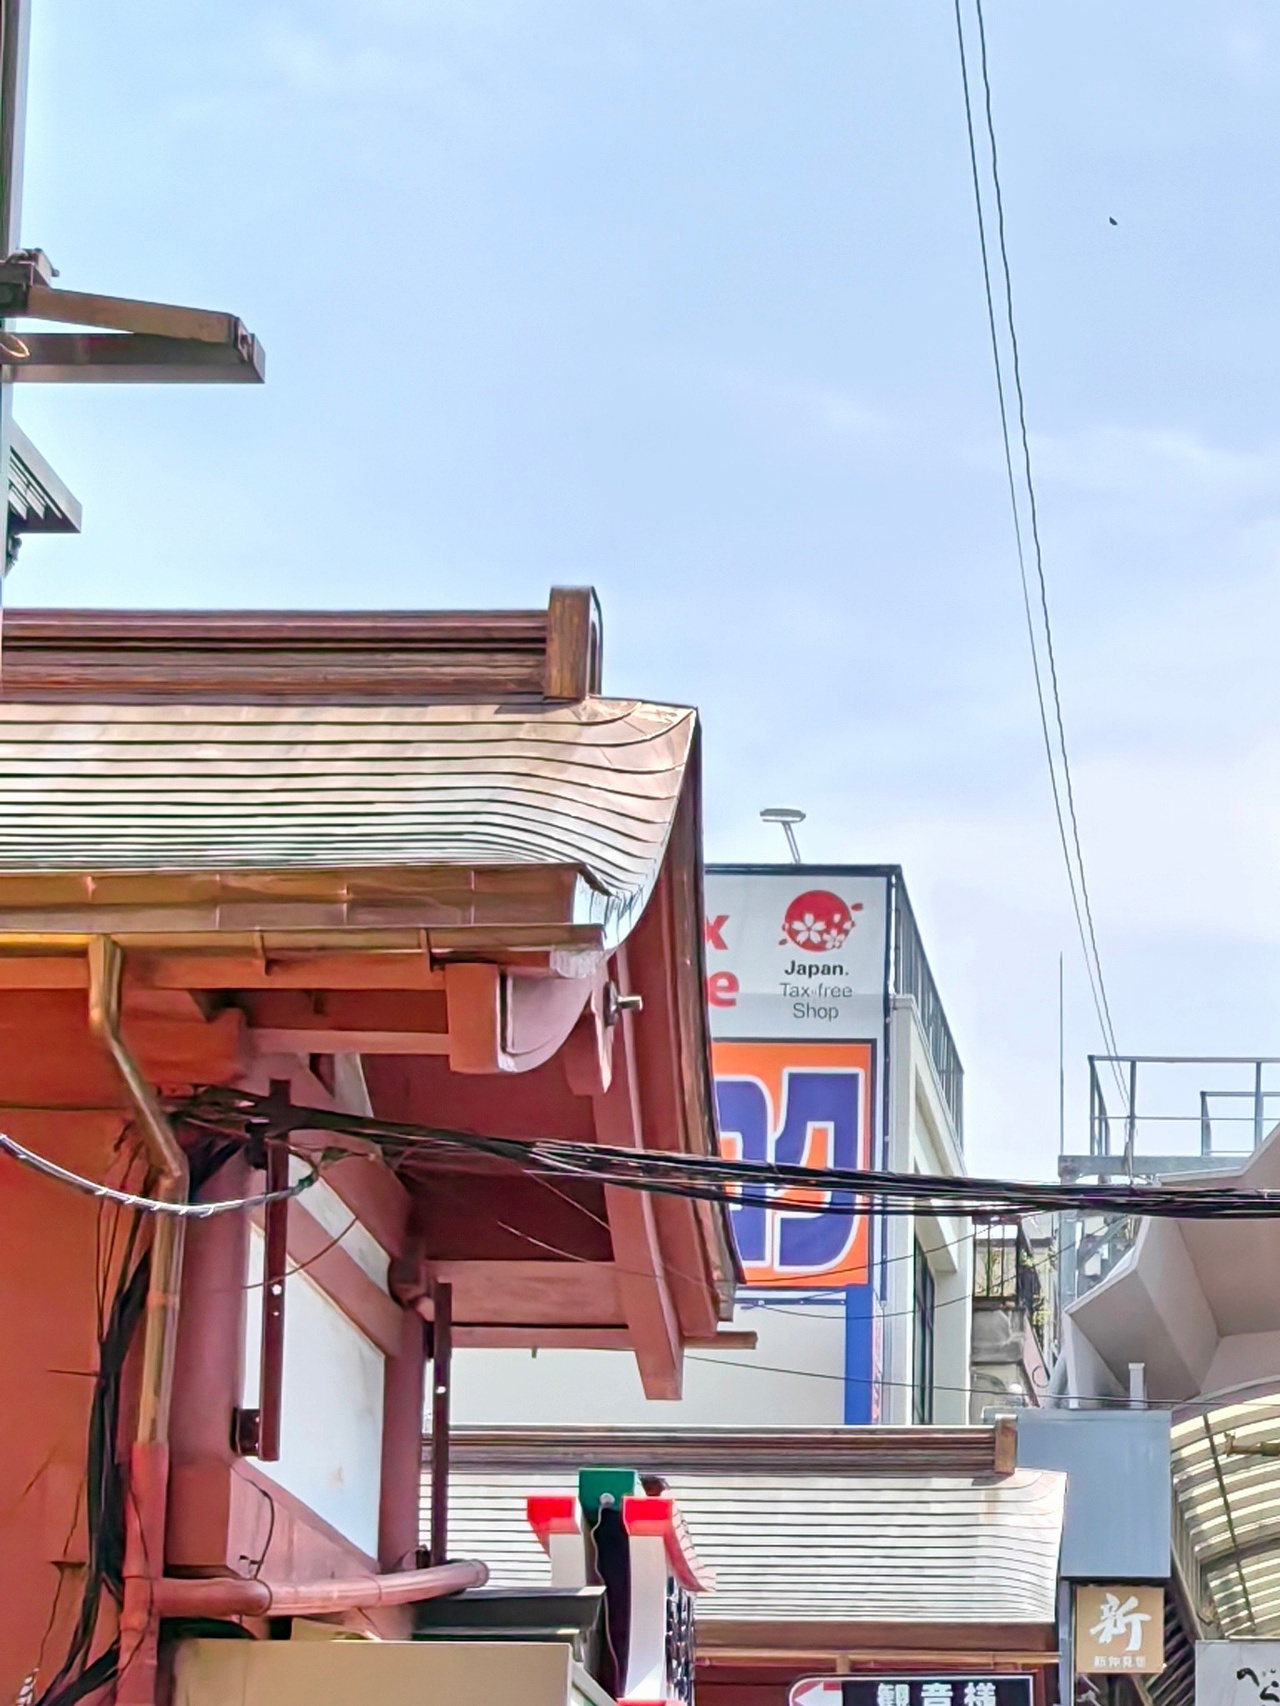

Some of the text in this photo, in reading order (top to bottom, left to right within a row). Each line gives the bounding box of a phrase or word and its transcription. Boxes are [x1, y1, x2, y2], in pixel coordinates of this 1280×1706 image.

[784, 960, 849, 978] Japan.
[792, 1002, 839, 1021] Shop
[1089, 1592, 1152, 1652] 新
